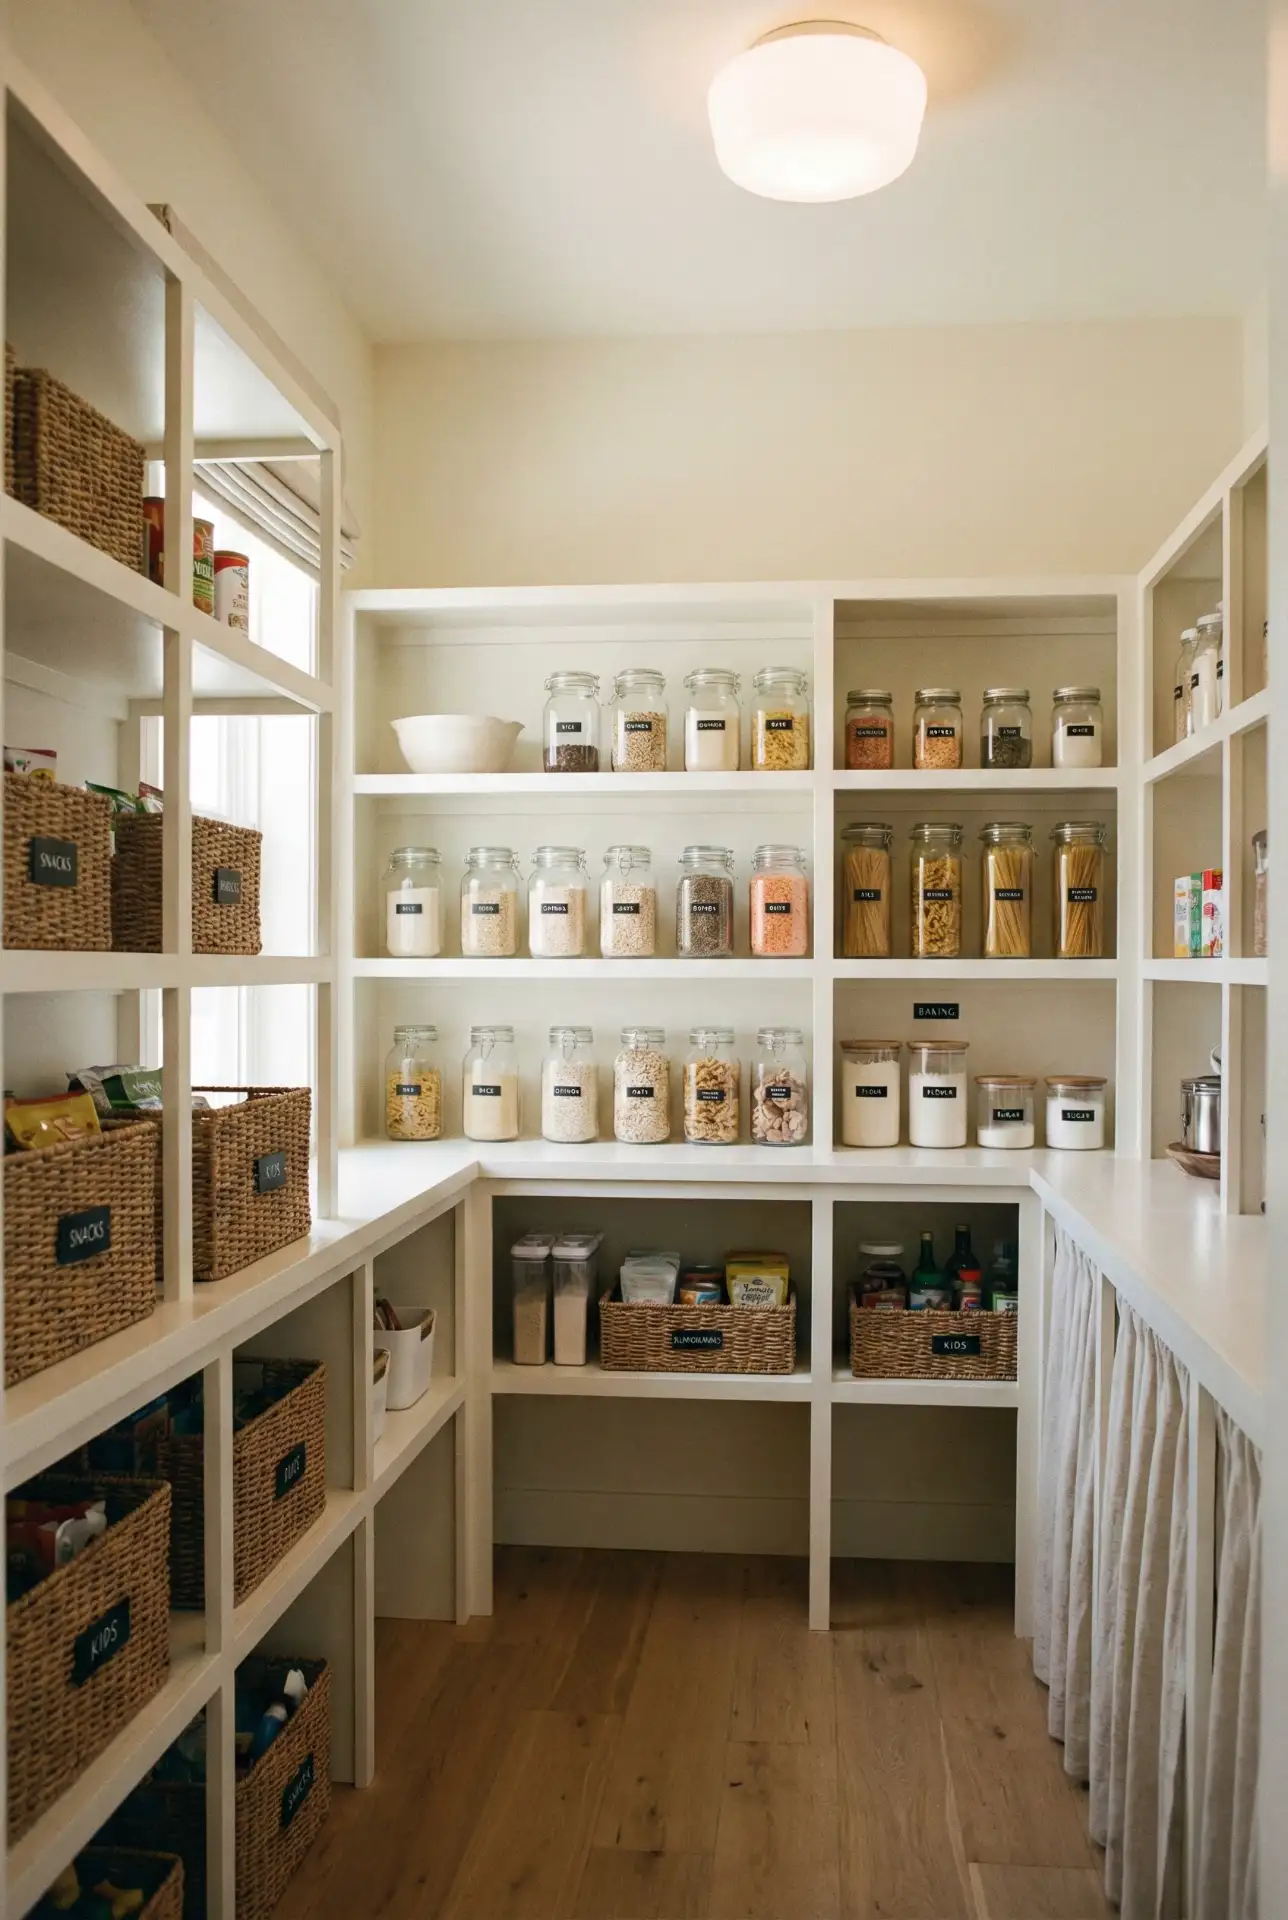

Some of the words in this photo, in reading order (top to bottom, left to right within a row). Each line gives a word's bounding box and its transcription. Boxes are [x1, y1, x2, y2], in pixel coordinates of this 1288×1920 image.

[40, 852, 72, 872] SNACKS
[918, 1007, 955, 1017] BAKING
[69, 1220, 104, 1248] SNACKS
[943, 1340, 968, 1350] KIDS
[90, 1618, 118, 1662] KIDS
